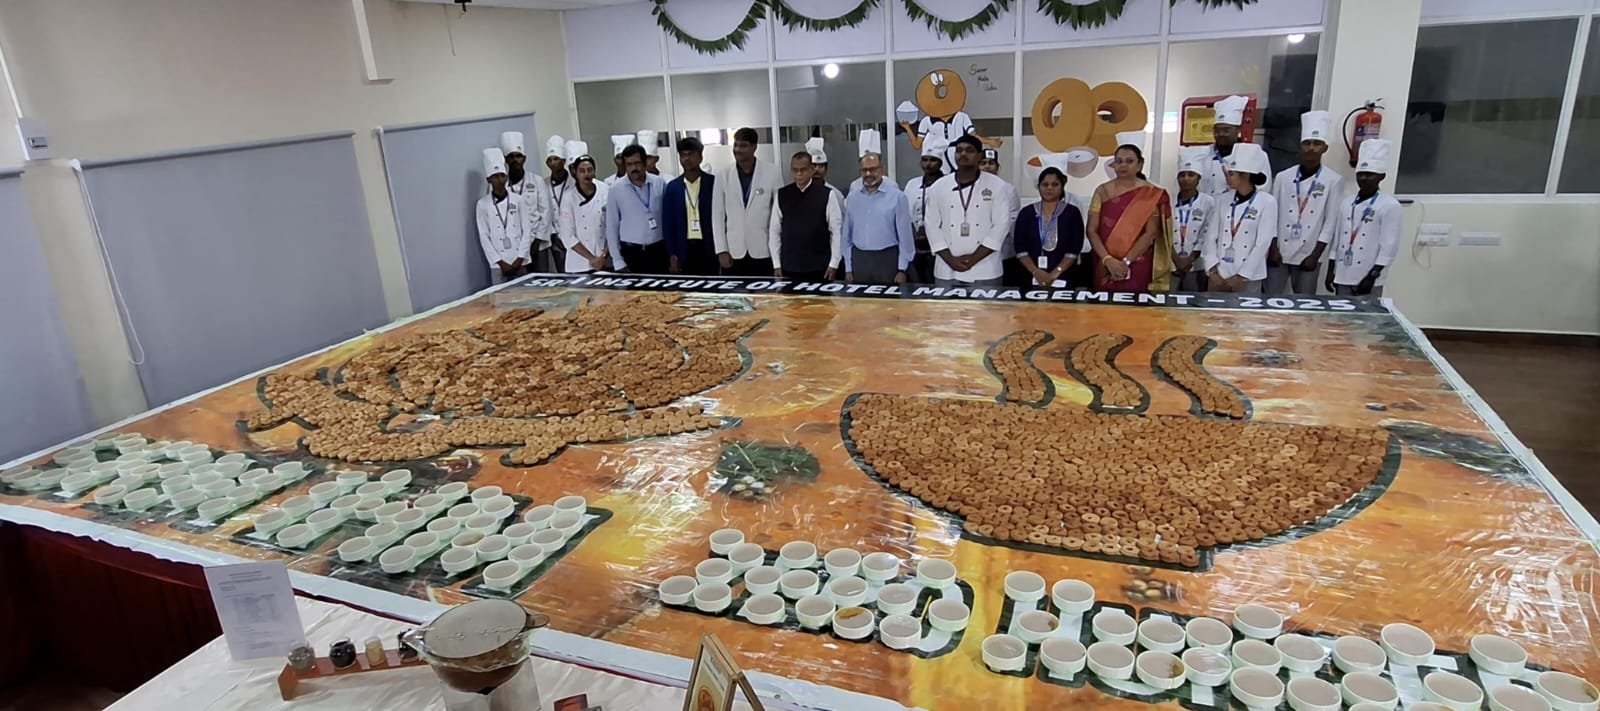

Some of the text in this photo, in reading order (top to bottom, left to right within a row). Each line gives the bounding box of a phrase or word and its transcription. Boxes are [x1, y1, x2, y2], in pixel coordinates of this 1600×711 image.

[585, 277, 744, 290] INSTITUTE
[746, 281, 792, 291] OF
[793, 281, 903, 295] HOTEL
[912, 287, 1196, 305] MANAGEMENT
[1238, 297, 1356, 311] 2025
